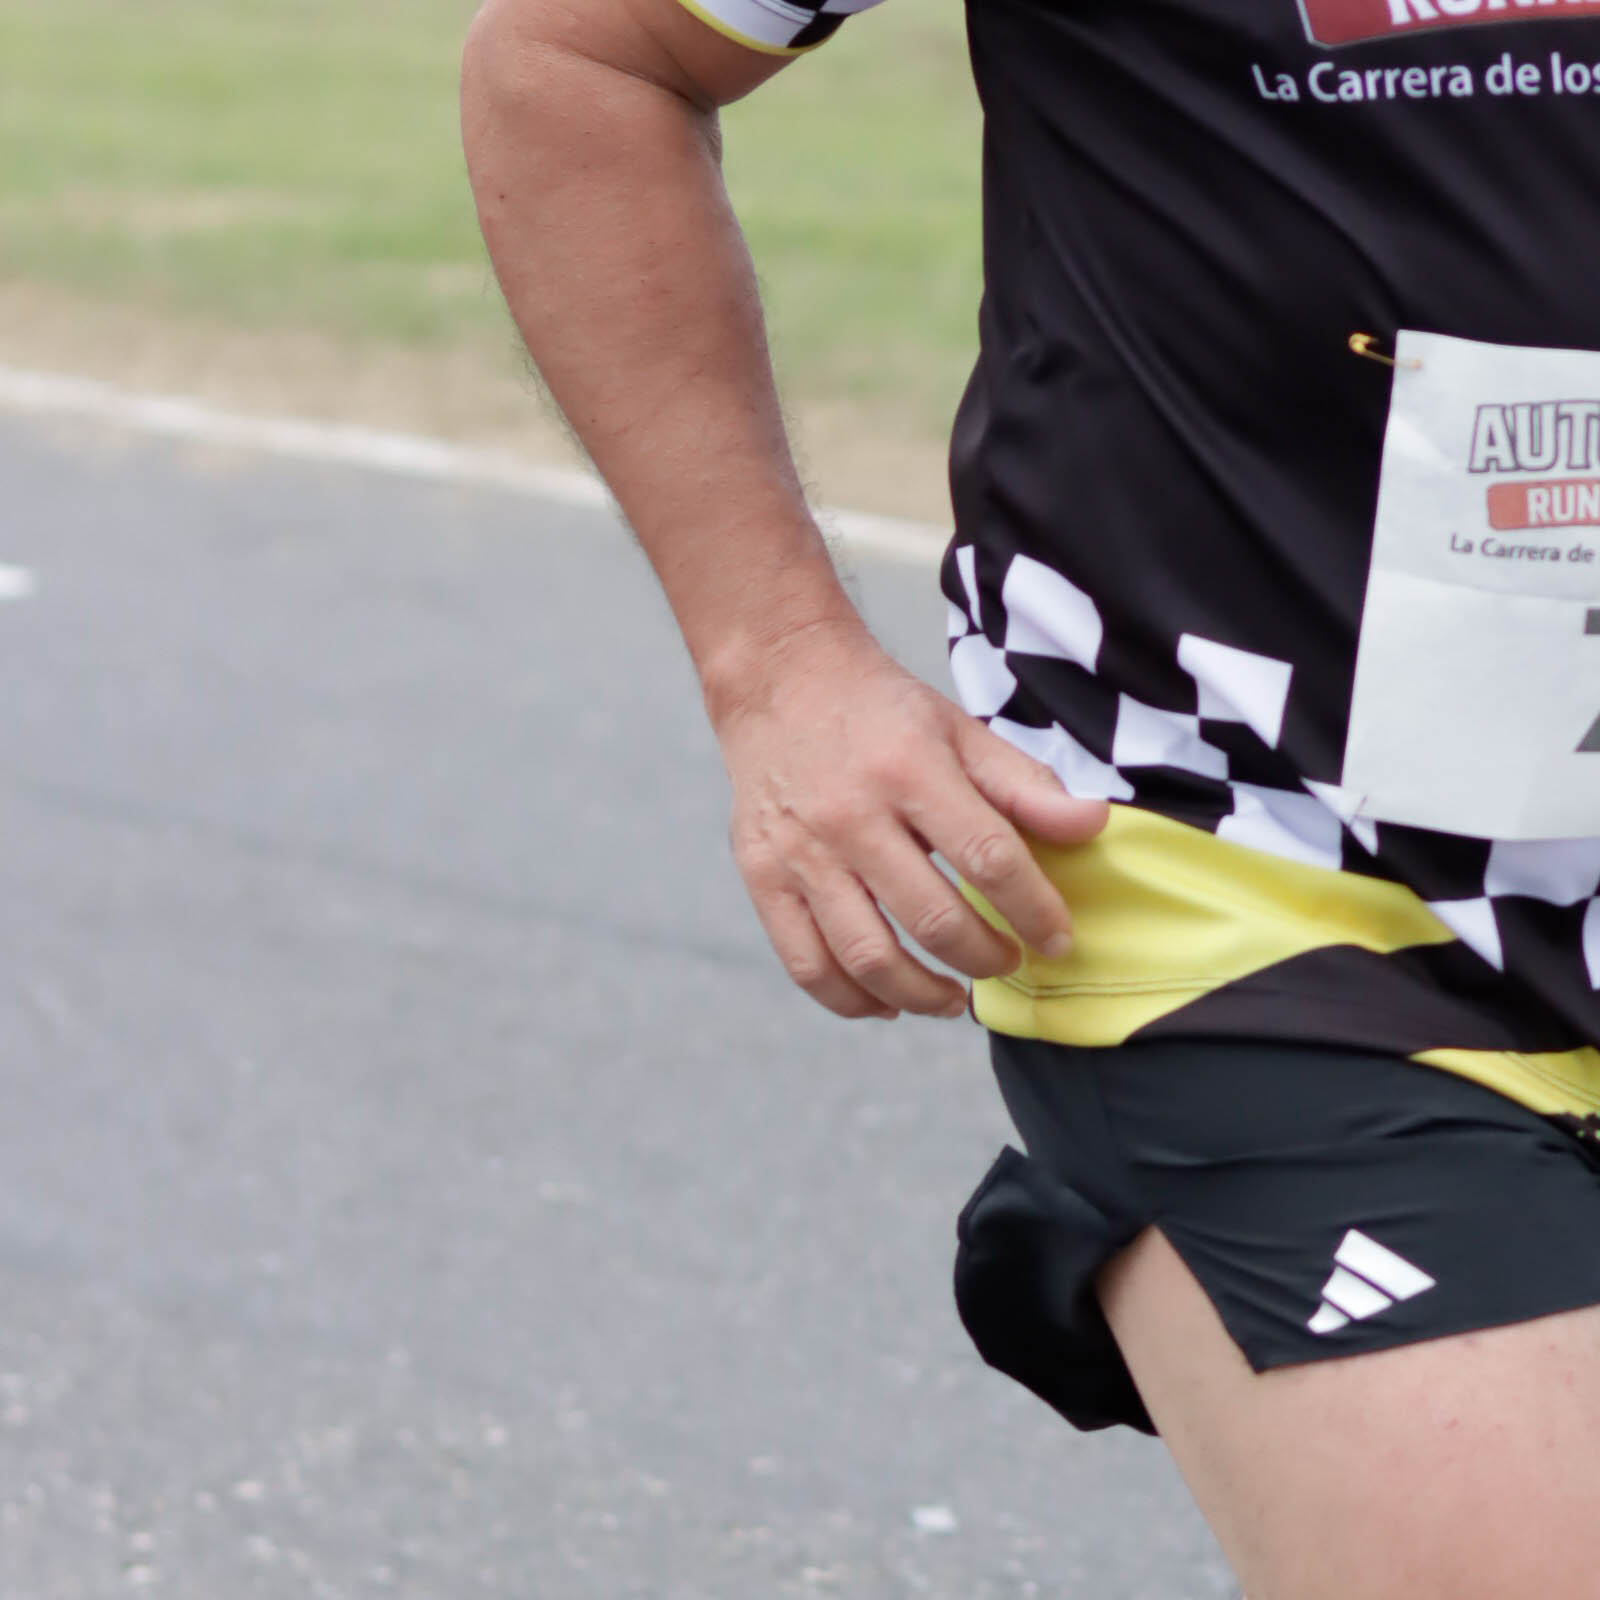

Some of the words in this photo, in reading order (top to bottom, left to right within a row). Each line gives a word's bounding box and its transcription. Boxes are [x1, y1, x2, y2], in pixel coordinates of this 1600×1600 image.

[1251, 63, 1299, 100] La
[1307, 61, 1474, 102] Carrera
[1485, 52, 1541, 95] de
[1450, 533, 1474, 554] La
[1481, 537, 1561, 563] Carrera
[1567, 543, 1596, 564] de
